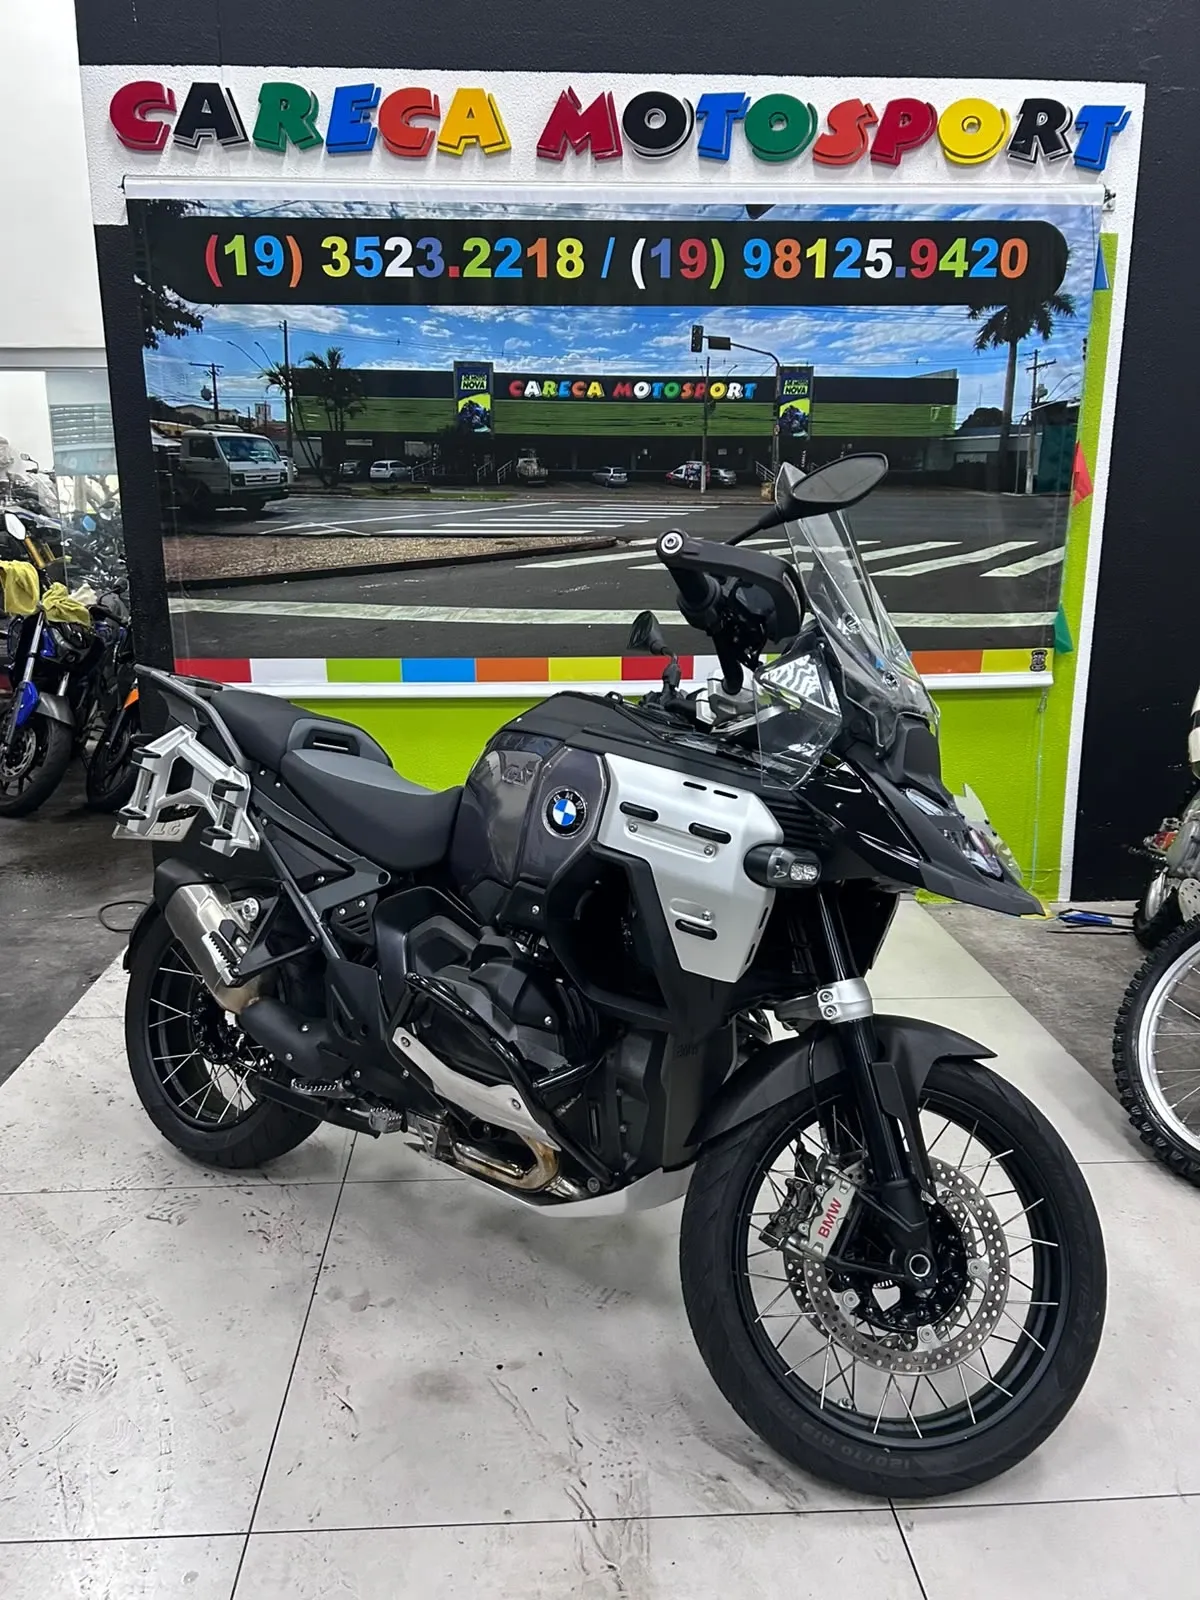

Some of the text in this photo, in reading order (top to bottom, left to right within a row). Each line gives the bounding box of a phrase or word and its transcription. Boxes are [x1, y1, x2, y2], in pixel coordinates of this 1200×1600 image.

[109, 80, 1131, 171] CARECA MOTOSPORT
[205, 234, 304, 288] (19)
[321, 234, 585, 279] 3523.2218
[631, 238, 725, 290] (19)
[743, 237, 1029, 281] 98125.9420
[462, 380, 485, 389] NOVA
[509, 379, 758, 400] CARECA MOTOSPORT
[785, 386, 806, 394] NOVA
[553, 791, 584, 810] BMW
[817, 1197, 842, 1239] BMW
